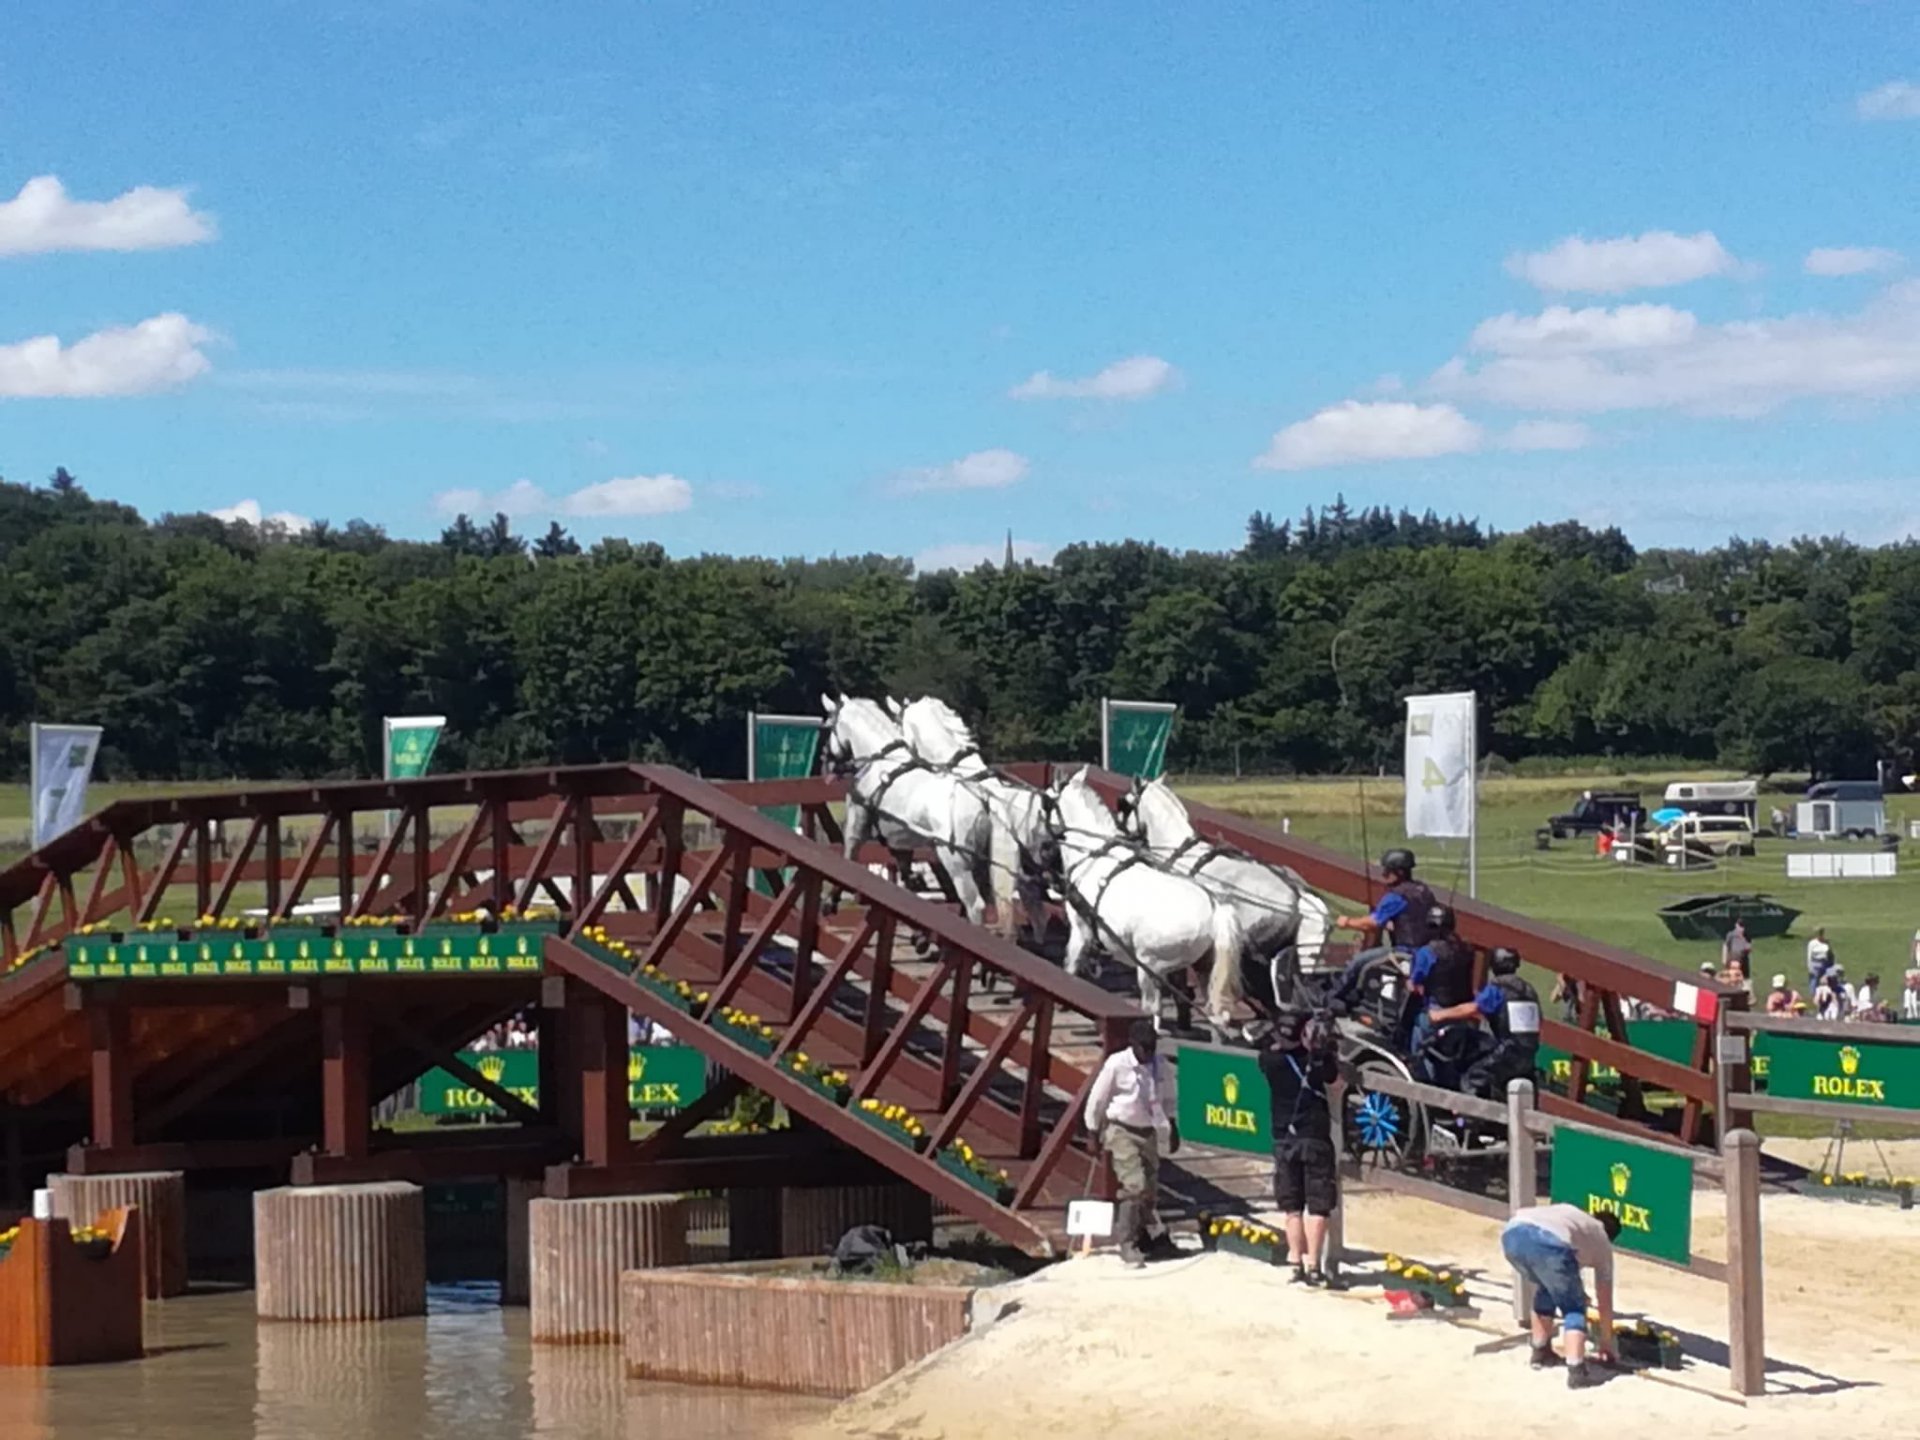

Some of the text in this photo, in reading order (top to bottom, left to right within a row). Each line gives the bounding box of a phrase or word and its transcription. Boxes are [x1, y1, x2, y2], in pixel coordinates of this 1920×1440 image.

[446, 1087, 540, 1109] ROX
[628, 1084, 679, 1103] LEX
[1813, 1075, 1885, 1100] ROLEX
[1205, 1103, 1256, 1132] ROLEX
